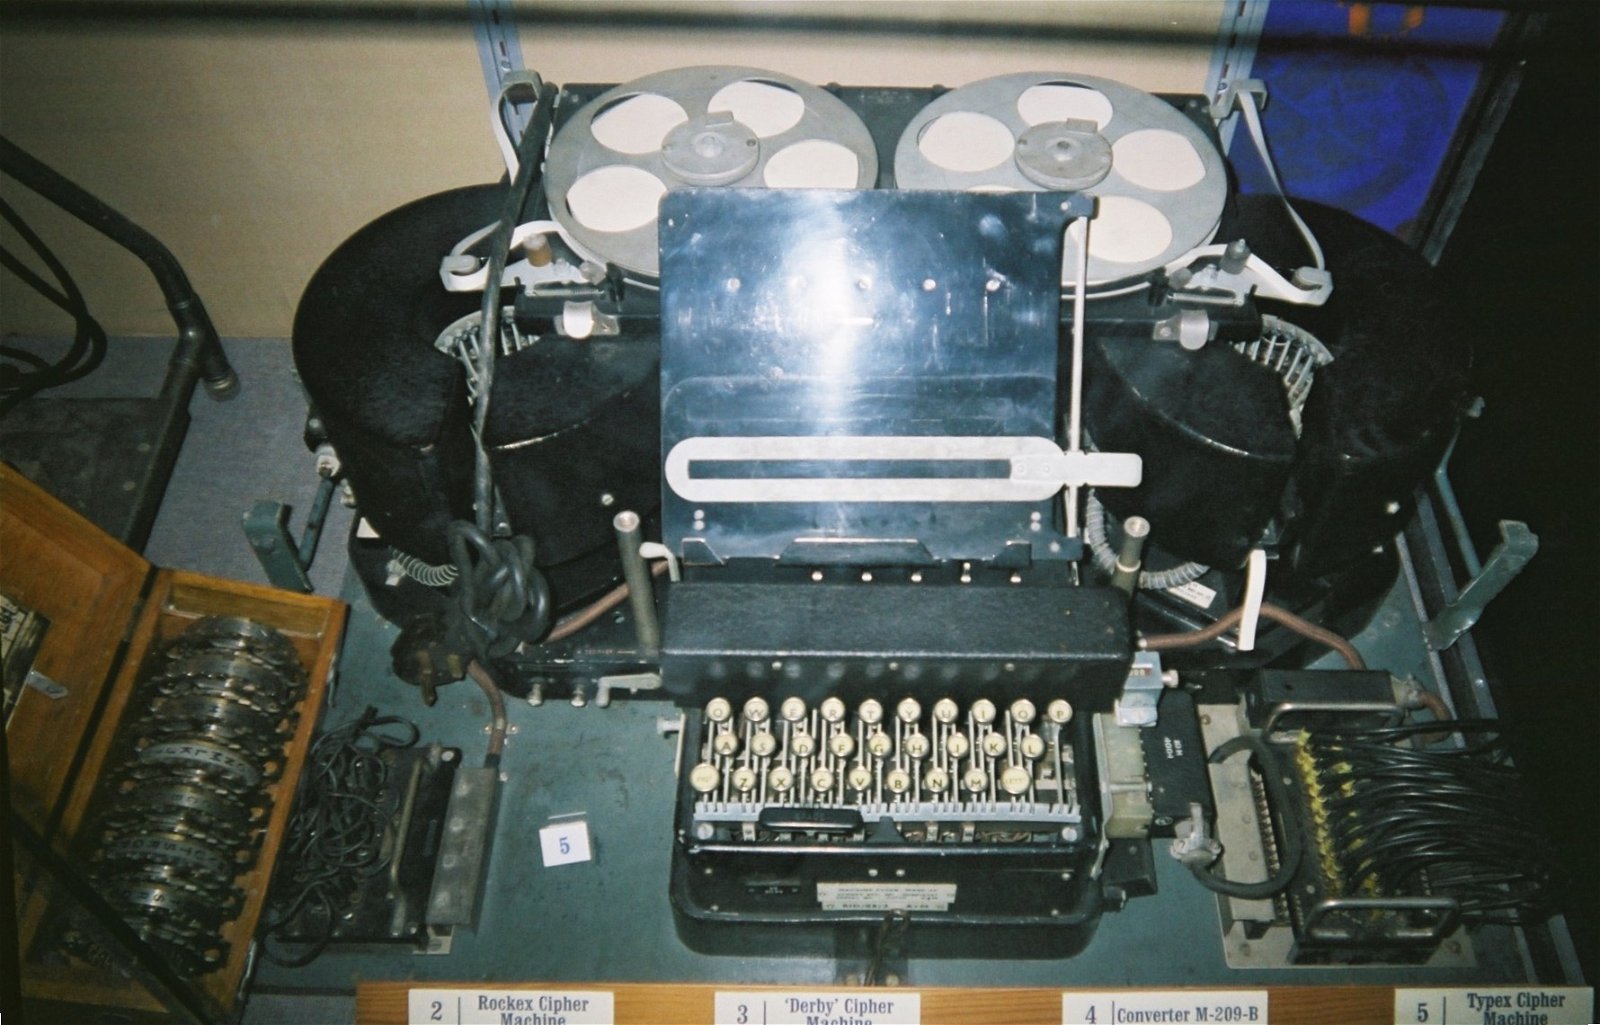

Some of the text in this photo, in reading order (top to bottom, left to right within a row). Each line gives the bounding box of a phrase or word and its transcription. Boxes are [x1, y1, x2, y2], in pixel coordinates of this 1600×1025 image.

[751, 709, 764, 718] W
[829, 710, 837, 718] R
[866, 710, 875, 718] T
[722, 741, 731, 751] A
[800, 744, 809, 753] D
[838, 744, 846, 753] F
[875, 743, 884, 753] G
[913, 744, 922, 753] H
[990, 743, 998, 752] K
[740, 778, 748, 788] Z
[777, 778, 784, 787] X
[817, 778, 825, 788] C
[856, 778, 865, 786] V
[933, 779, 942, 788] N
[971, 779, 982, 788] M
[559, 836, 570, 854] 5
[431, 1001, 442, 1021] 2
[478, 995, 589, 1014] Rockex Cipher
[844, 998, 894, 1016] Cipher
[1467, 992, 1566, 1012] Typex Cipher
[500, 1013, 566, 1025] Machine
[737, 1004, 748, 1024] 3
[1085, 1006, 1097, 1024] 4
[1117, 1006, 1259, 1024] Converter M-209-B
[1417, 1003, 1429, 1022] 5
[1484, 1012, 1548, 1025] Machine
